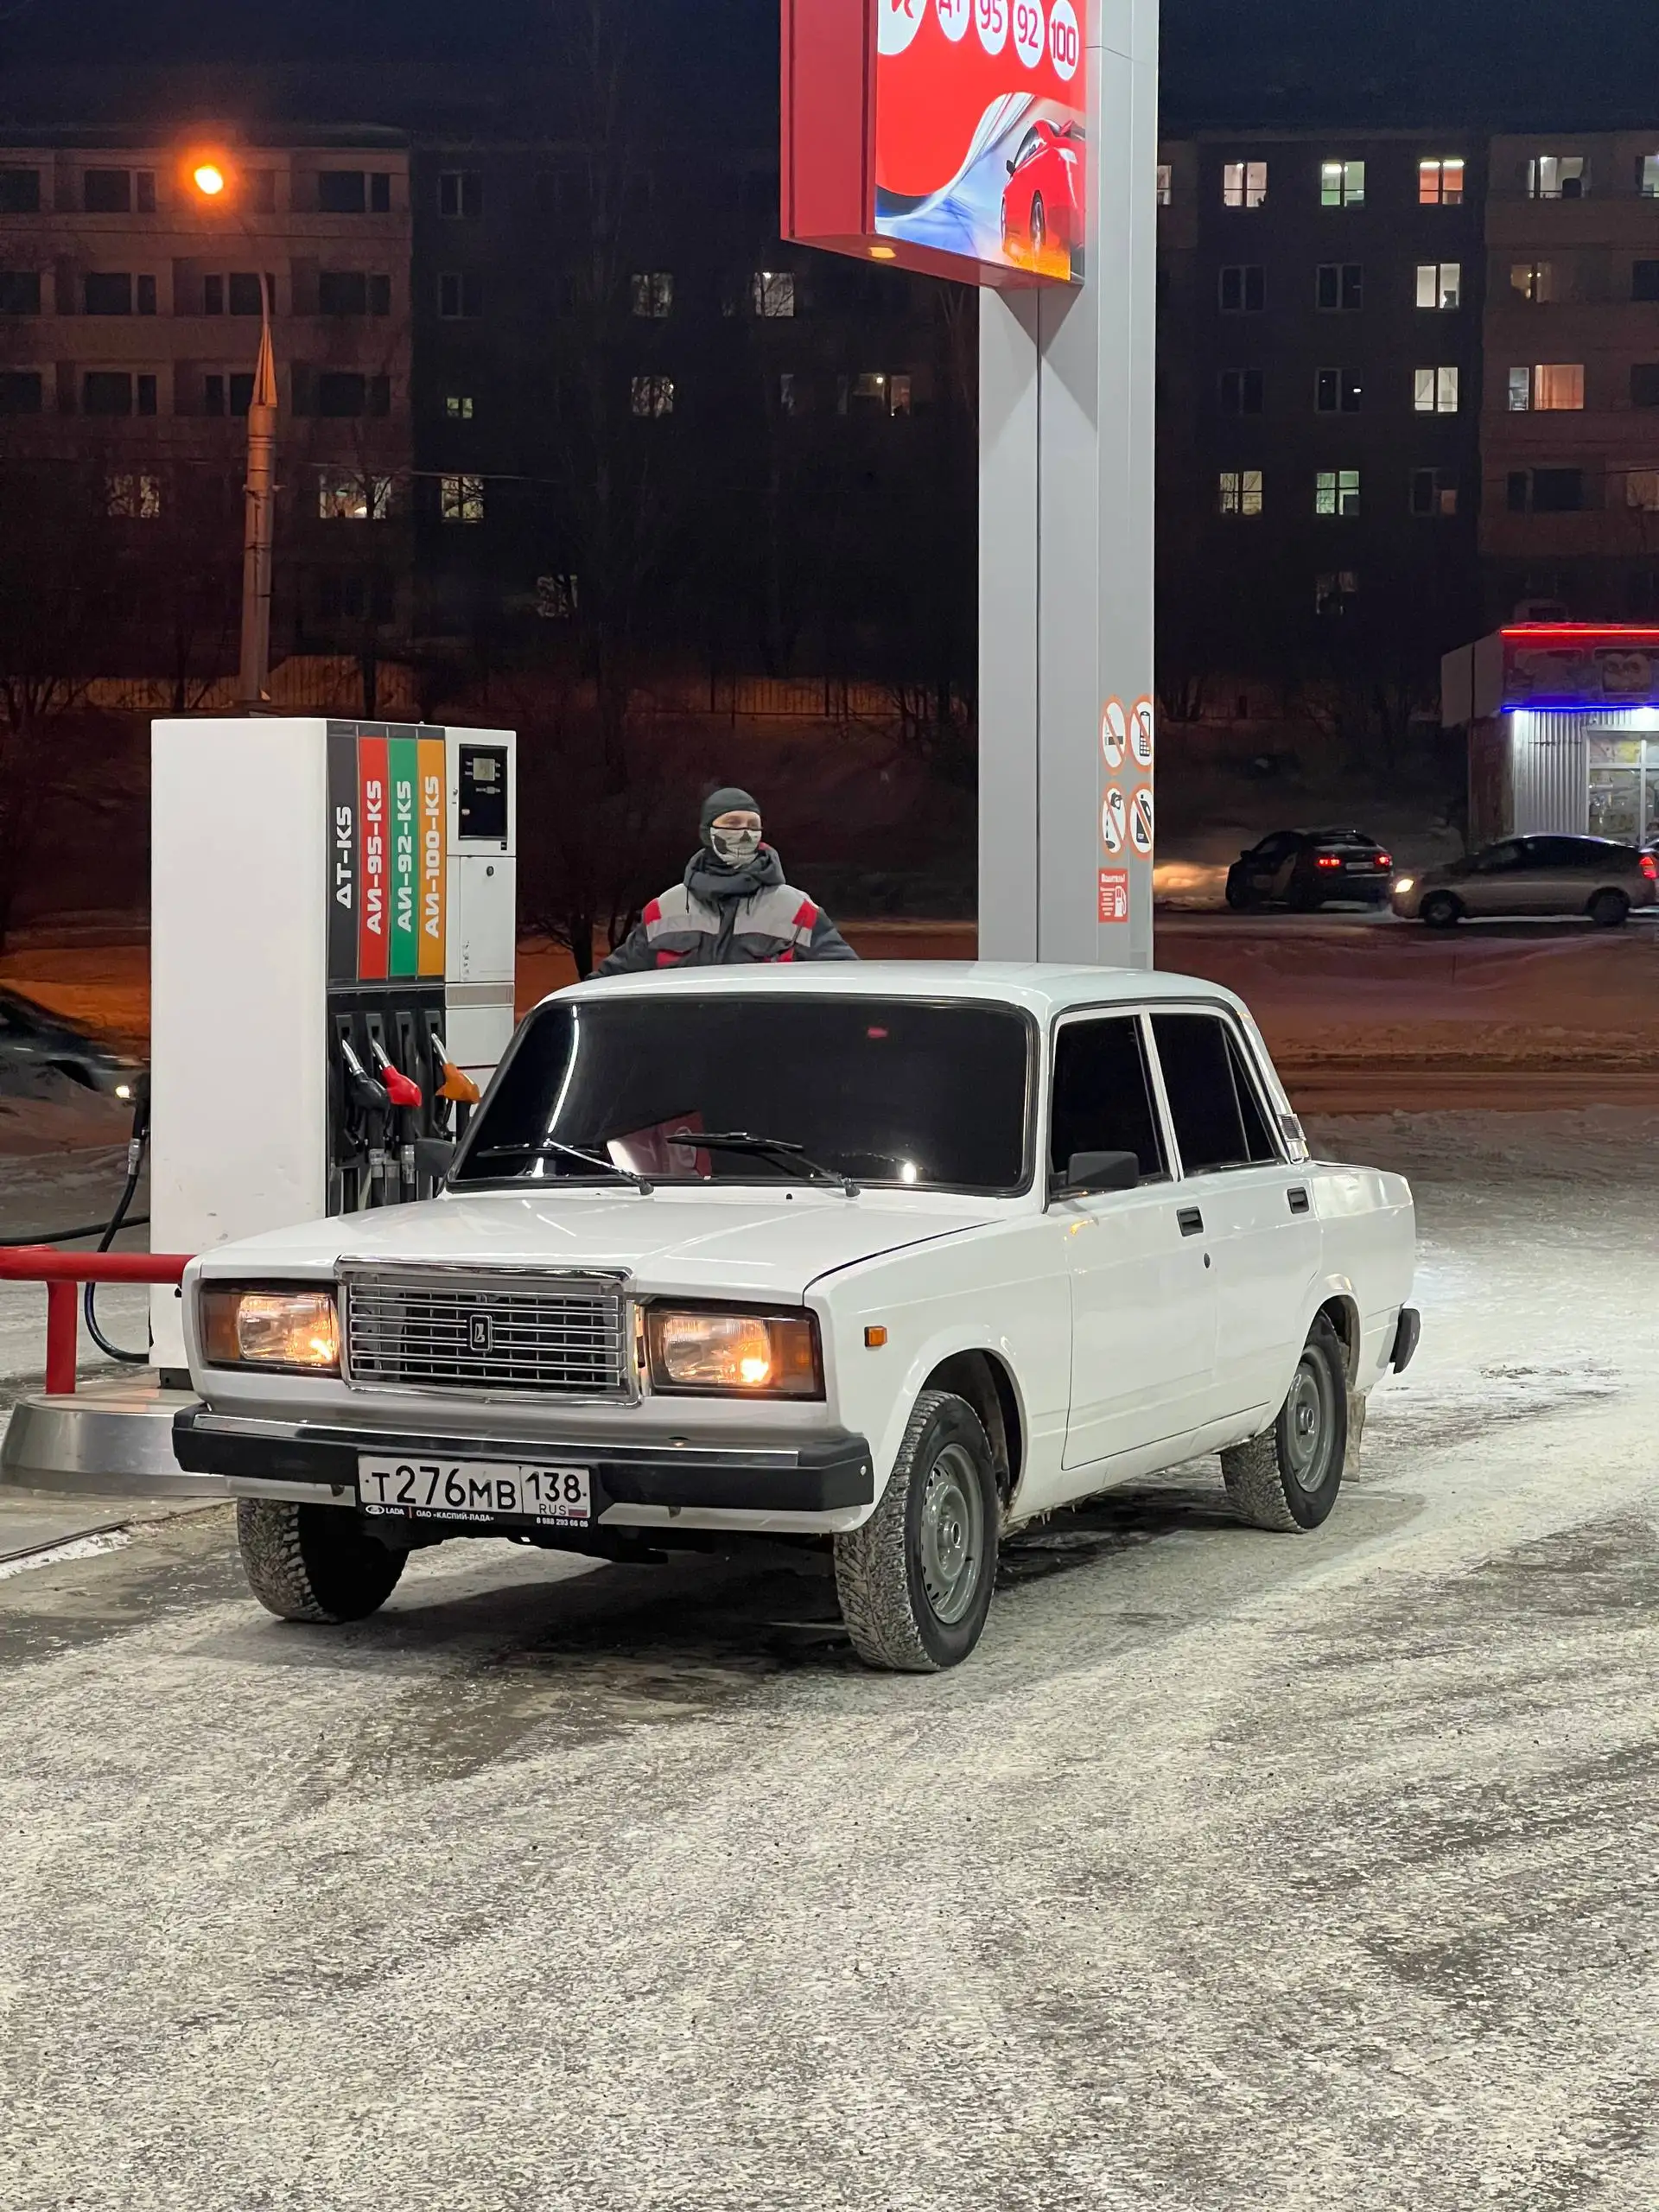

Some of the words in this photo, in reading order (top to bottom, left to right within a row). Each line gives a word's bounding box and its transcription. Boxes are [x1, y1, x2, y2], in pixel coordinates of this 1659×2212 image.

[980, 0, 1002, 34] 95
[1017, 3, 1039, 49] 92
[1051, 18, 1077, 67] 100
[366, 779, 382, 935] АИ-95-К5
[397, 780, 412, 933] АИ-92-К5
[424, 775, 440, 938] АИ-100-К5
[371, 1465, 517, 1510] Т276МВ
[524, 1471, 582, 1503] 138
[385, 1507, 405, 1516] LADA
[416, 1510, 432, 1518] ОАО
[538, 1503, 567, 1516] RUS
